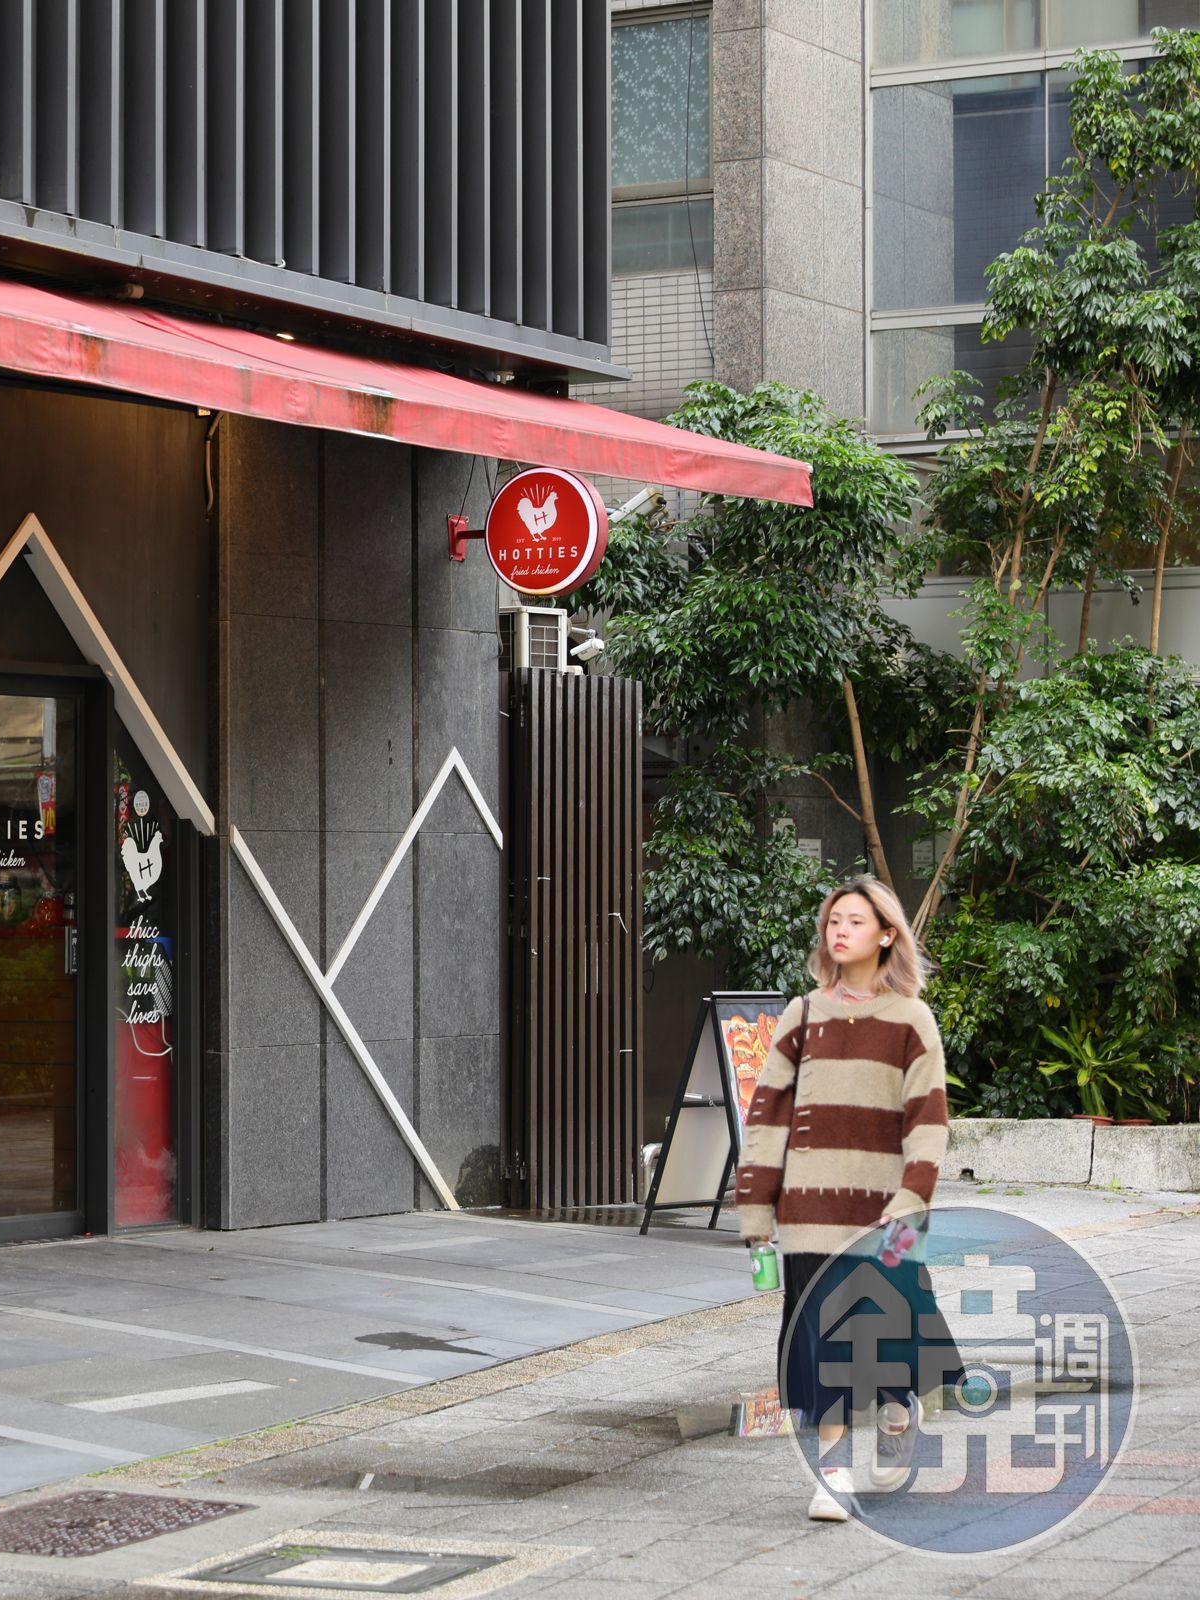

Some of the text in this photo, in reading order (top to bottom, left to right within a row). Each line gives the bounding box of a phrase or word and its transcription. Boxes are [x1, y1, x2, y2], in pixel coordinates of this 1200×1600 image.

[498, 546, 578, 561] HOTTIES
[511, 564, 560, 580] fried chicken
[126, 914, 160, 938] thicc
[121, 943, 165, 978] thighs
[127, 982, 159, 996] save
[126, 1000, 160, 1024] lives
